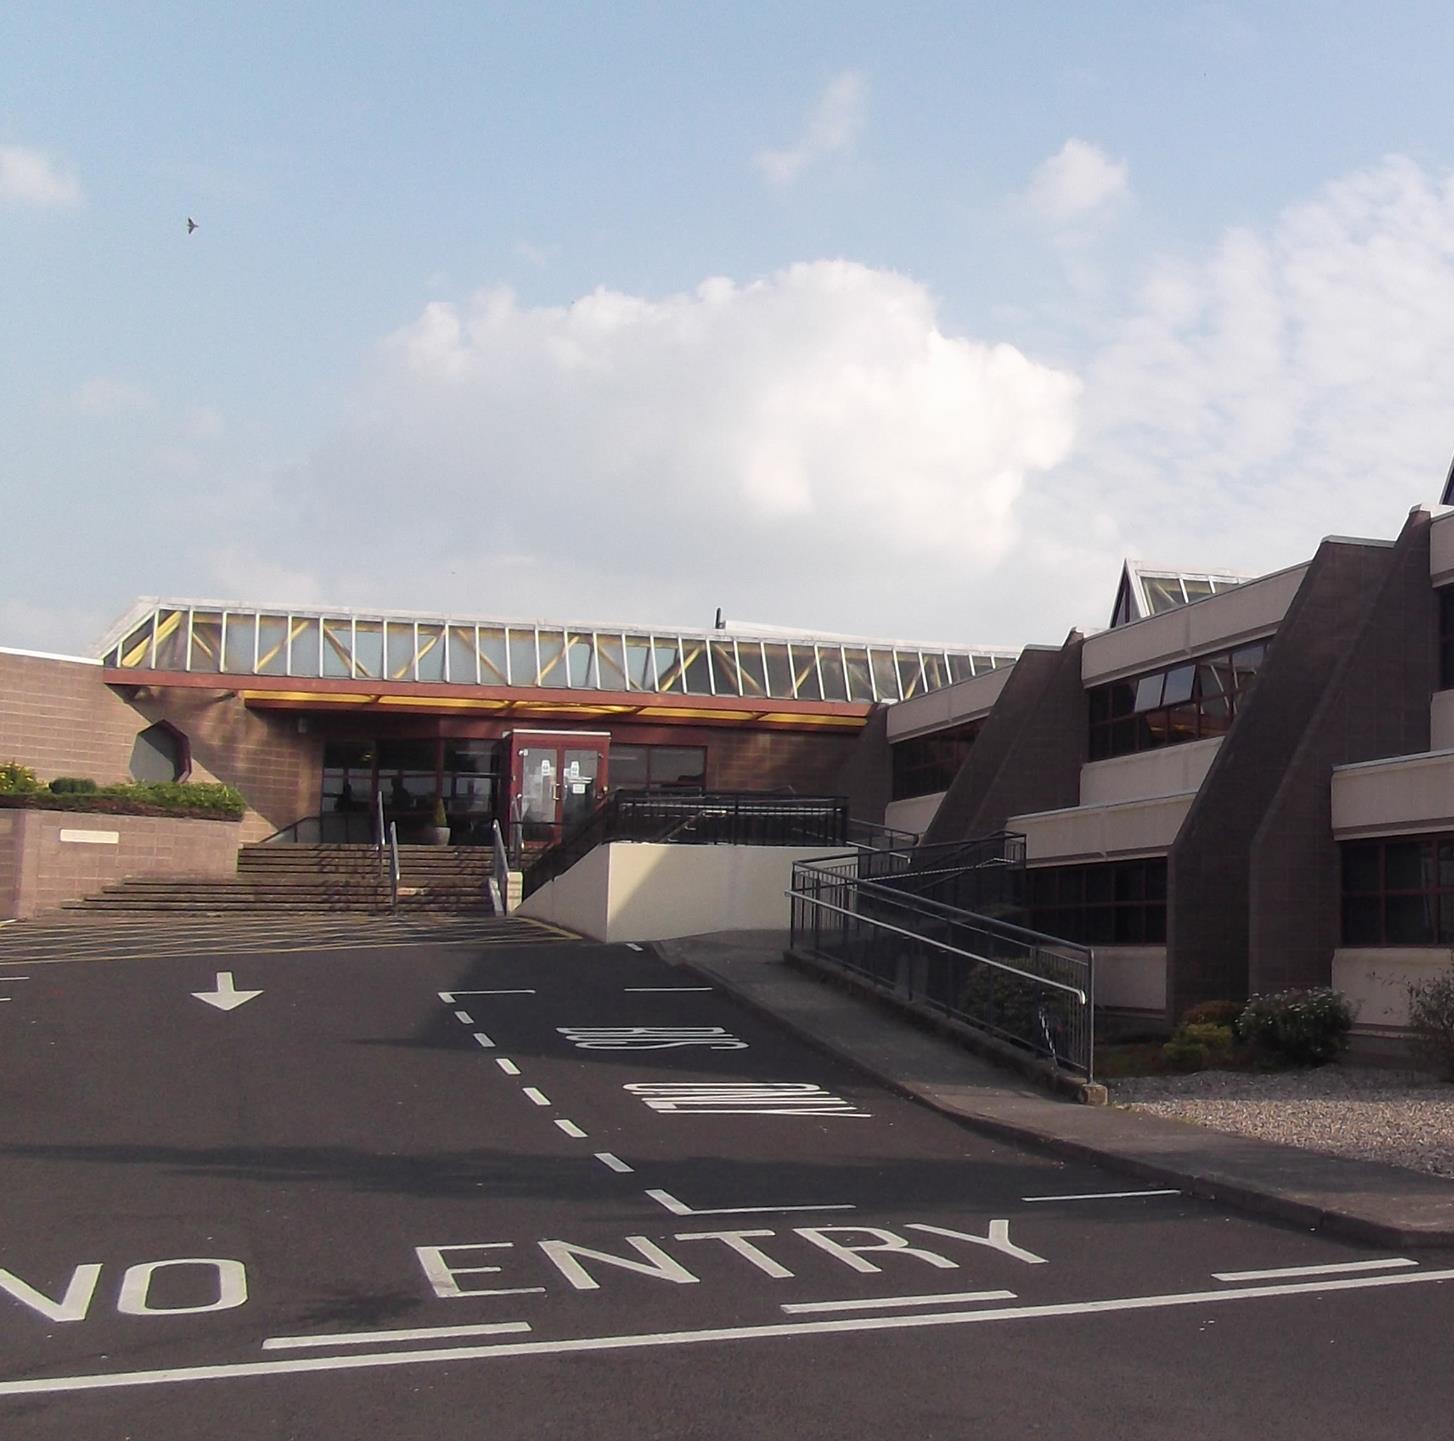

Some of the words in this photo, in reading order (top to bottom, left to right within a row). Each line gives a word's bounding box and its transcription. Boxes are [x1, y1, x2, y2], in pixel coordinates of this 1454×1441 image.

[556, 1027, 749, 1050] BUS
[623, 1083, 871, 1117] ONLY
[416, 1220, 1048, 1298] ENTRY
